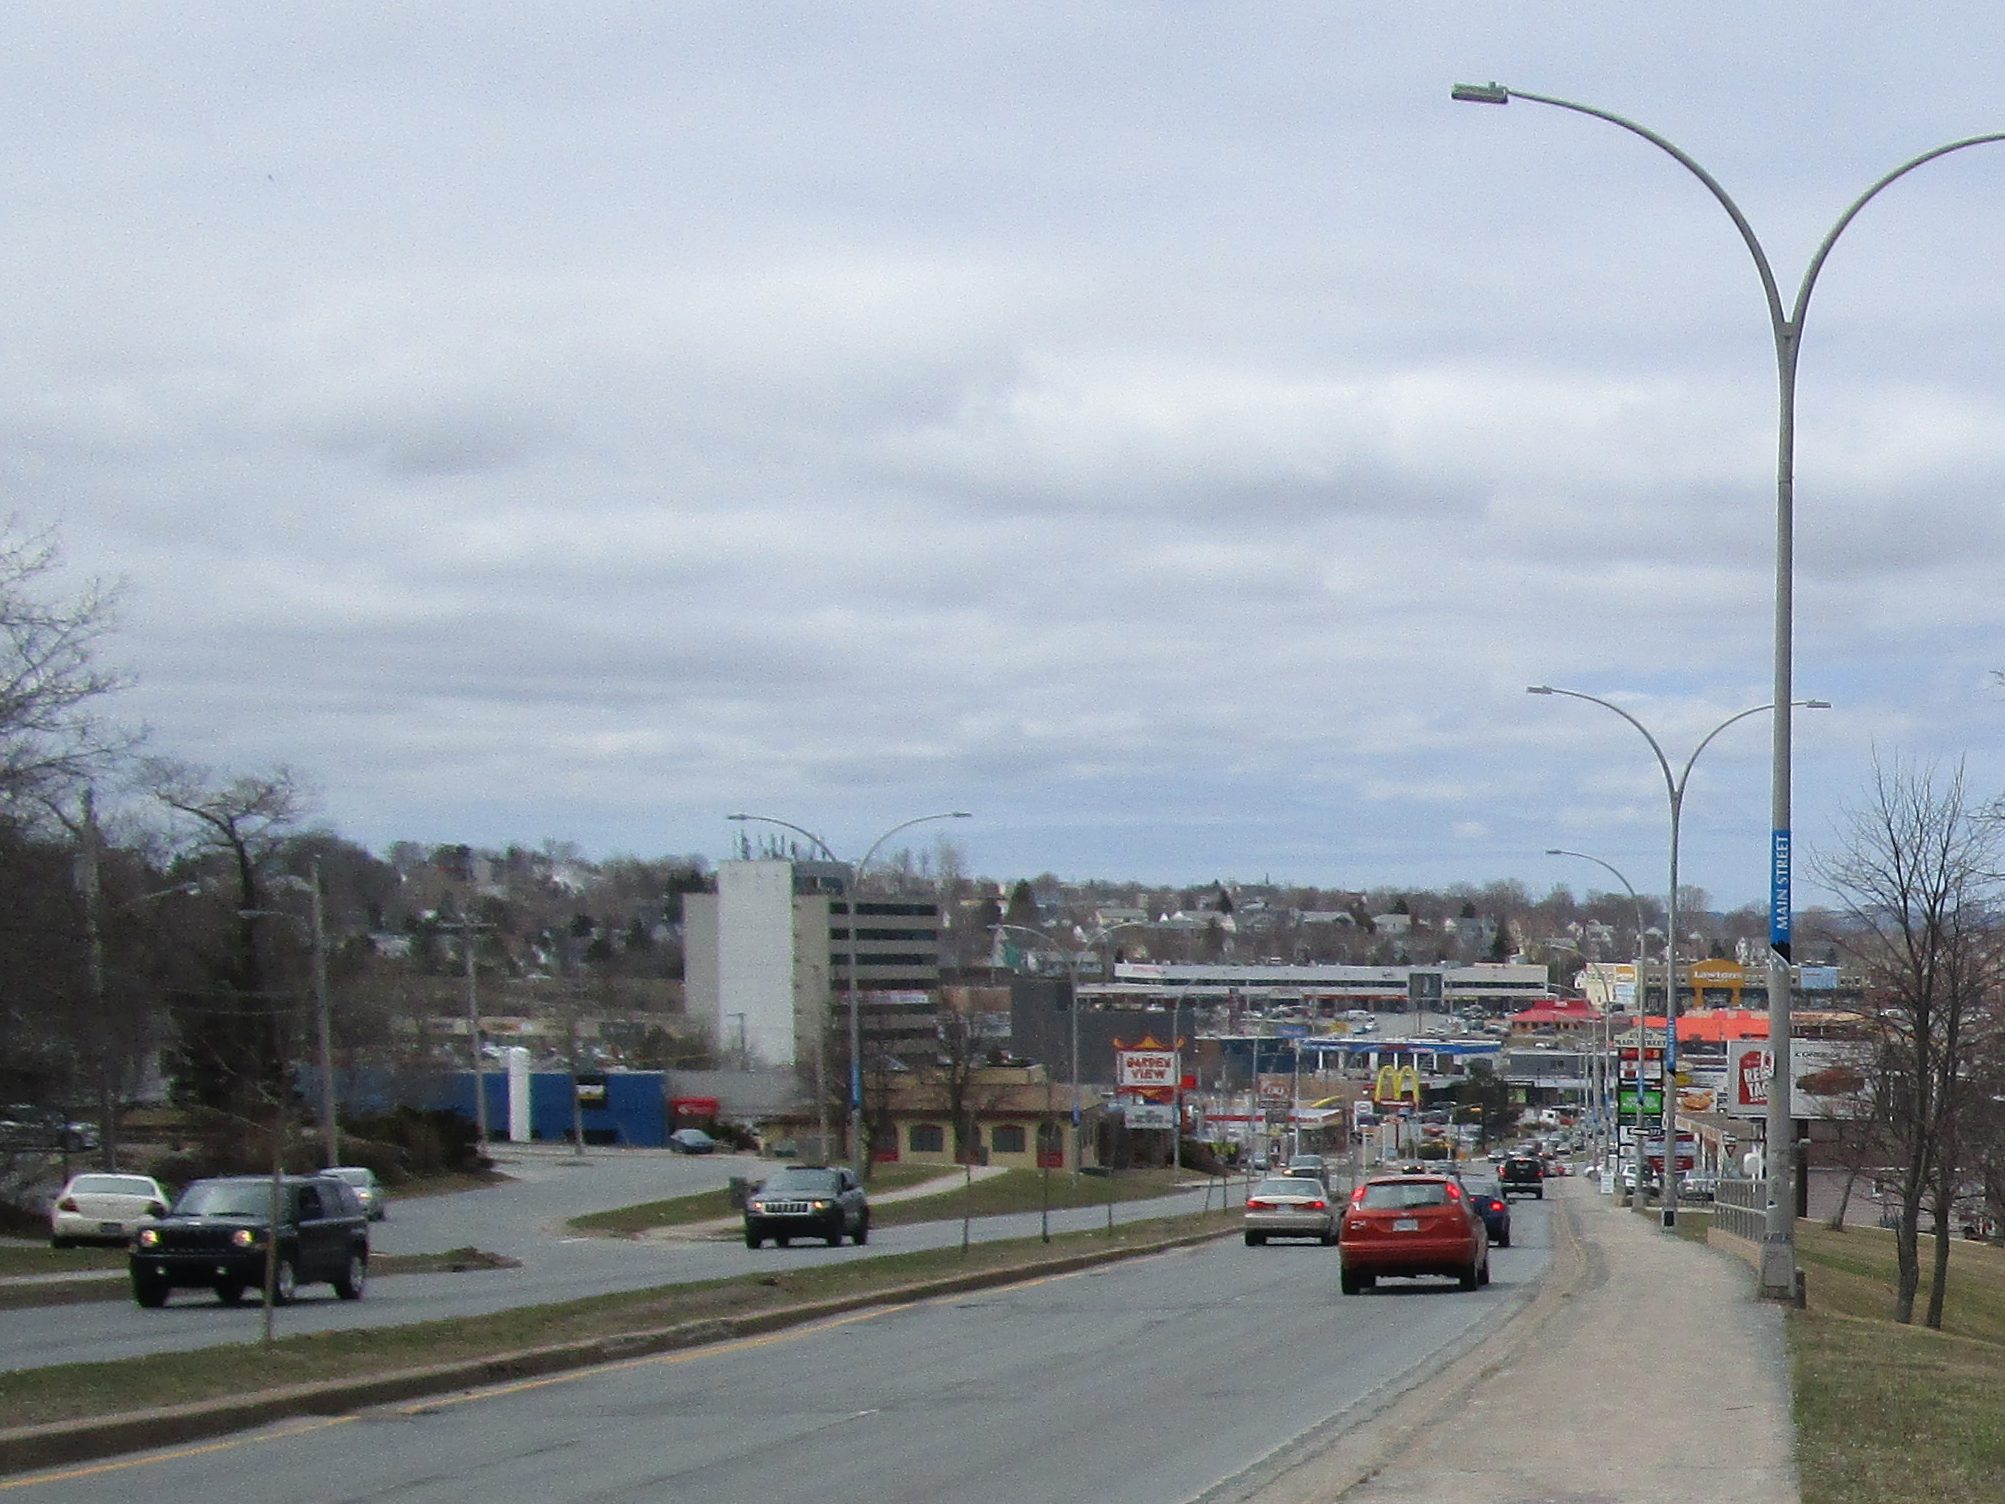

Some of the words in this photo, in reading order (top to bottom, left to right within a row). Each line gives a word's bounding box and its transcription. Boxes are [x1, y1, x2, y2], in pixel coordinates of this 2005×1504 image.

[1776, 835, 1789, 885] STREET
[1776, 889, 1789, 930] MAIN
[1126, 1057, 1172, 1068] GARDEN
[1130, 1069, 1167, 1079] VIEW
